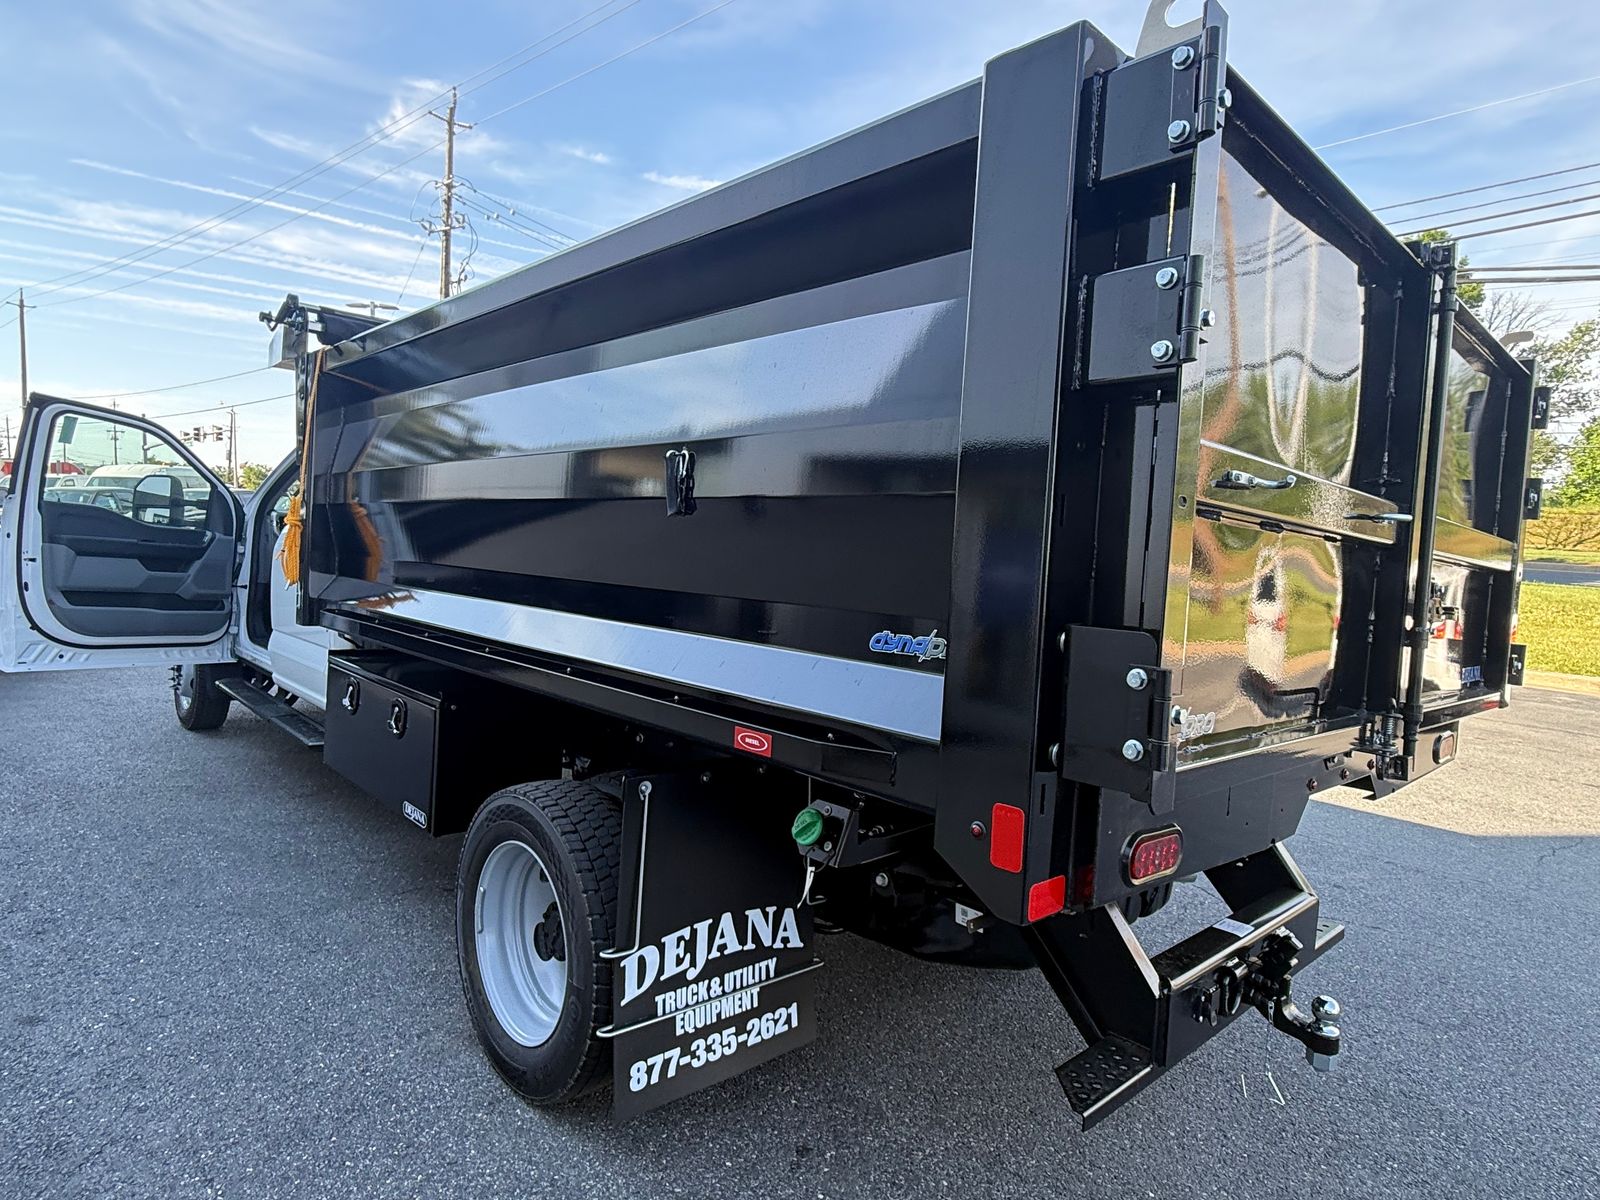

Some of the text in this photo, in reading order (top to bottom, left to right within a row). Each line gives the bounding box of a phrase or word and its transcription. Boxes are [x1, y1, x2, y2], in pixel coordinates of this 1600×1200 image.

[620, 906, 804, 1007] DEJANA
[629, 1002, 798, 1092] 877-335-2621
[675, 987, 760, 1036] EQUIPMENT
